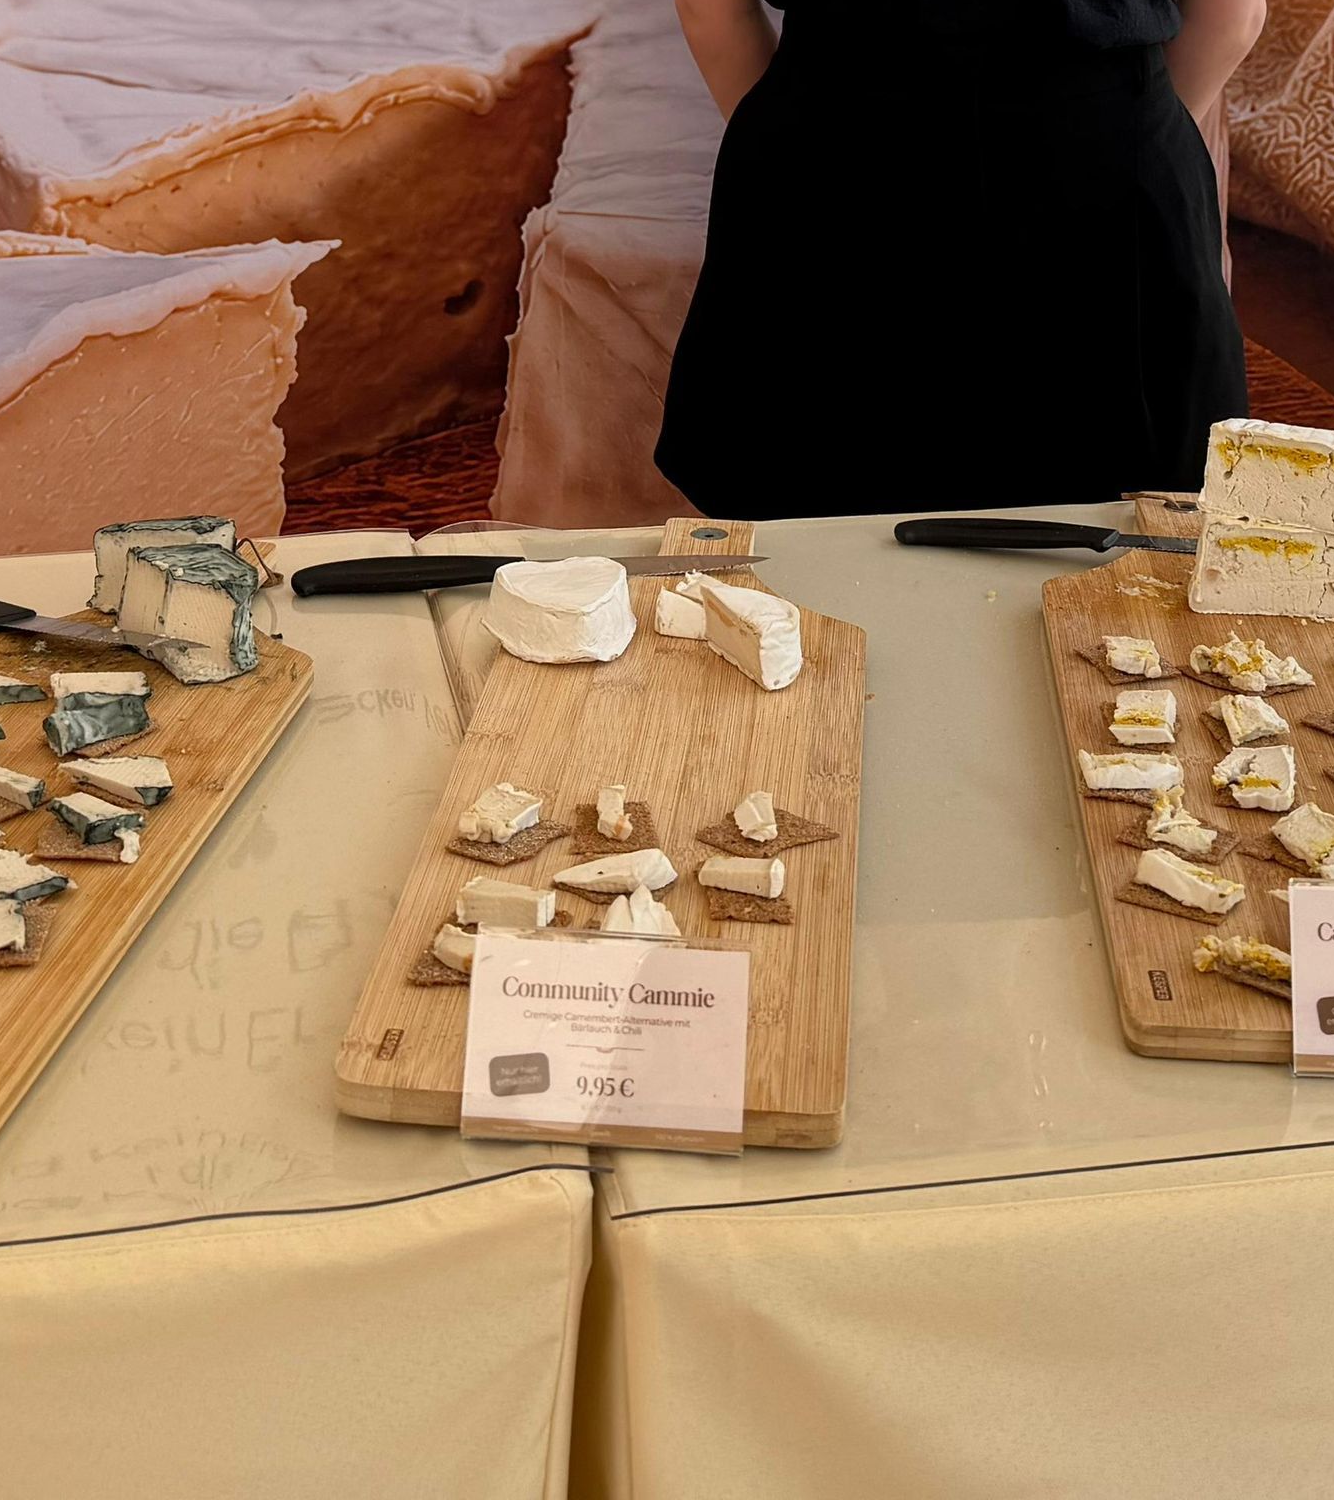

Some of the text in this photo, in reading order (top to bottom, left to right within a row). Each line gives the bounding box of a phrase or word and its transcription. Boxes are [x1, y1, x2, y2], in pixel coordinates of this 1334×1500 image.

[503, 976, 715, 1008] Community Cammie
[674, 1019, 690, 1027] mit
[620, 1078, 634, 1097] €
